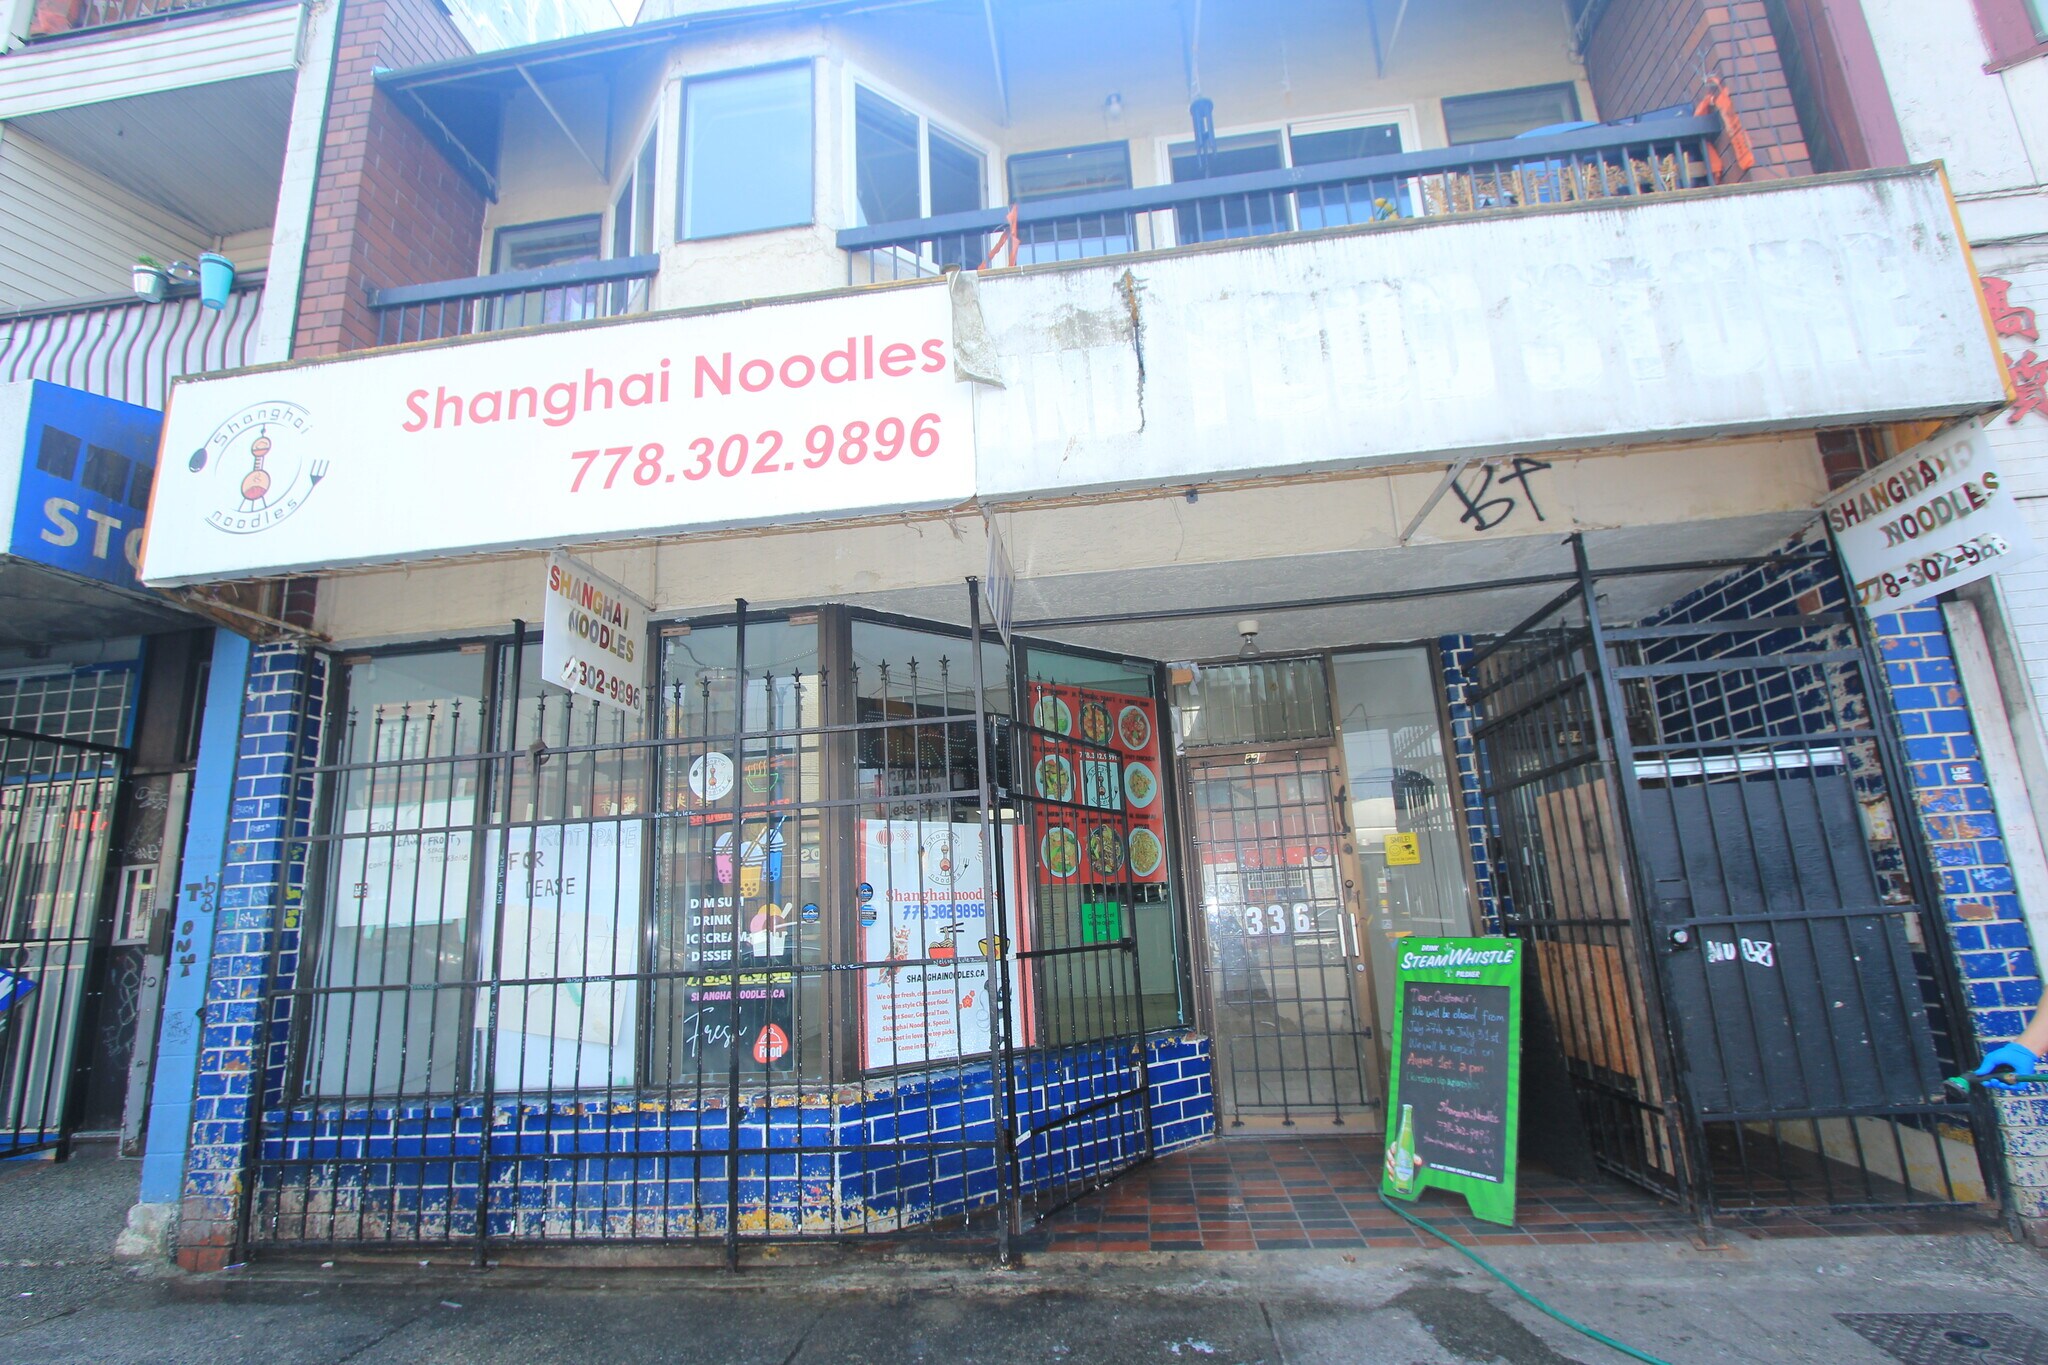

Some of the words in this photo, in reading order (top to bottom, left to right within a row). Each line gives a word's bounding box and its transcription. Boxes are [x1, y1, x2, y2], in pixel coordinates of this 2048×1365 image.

[402, 357, 671, 433] Shanghai
[694, 334, 948, 399] Noodles
[214, 406, 314, 448] Shanghai
[568, 412, 942, 493] 778.302.9896
[211, 498, 298, 530] noodles
[549, 564, 630, 631] SHANGHAI
[568, 608, 635, 663] NOODLES
[508, 851, 545, 871] FOR
[526, 876, 576, 899] LEASE
[693, 914, 733, 926] DRINK
[1246, 903, 1310, 935] 336
[1421, 944, 1440, 952] DRINK
